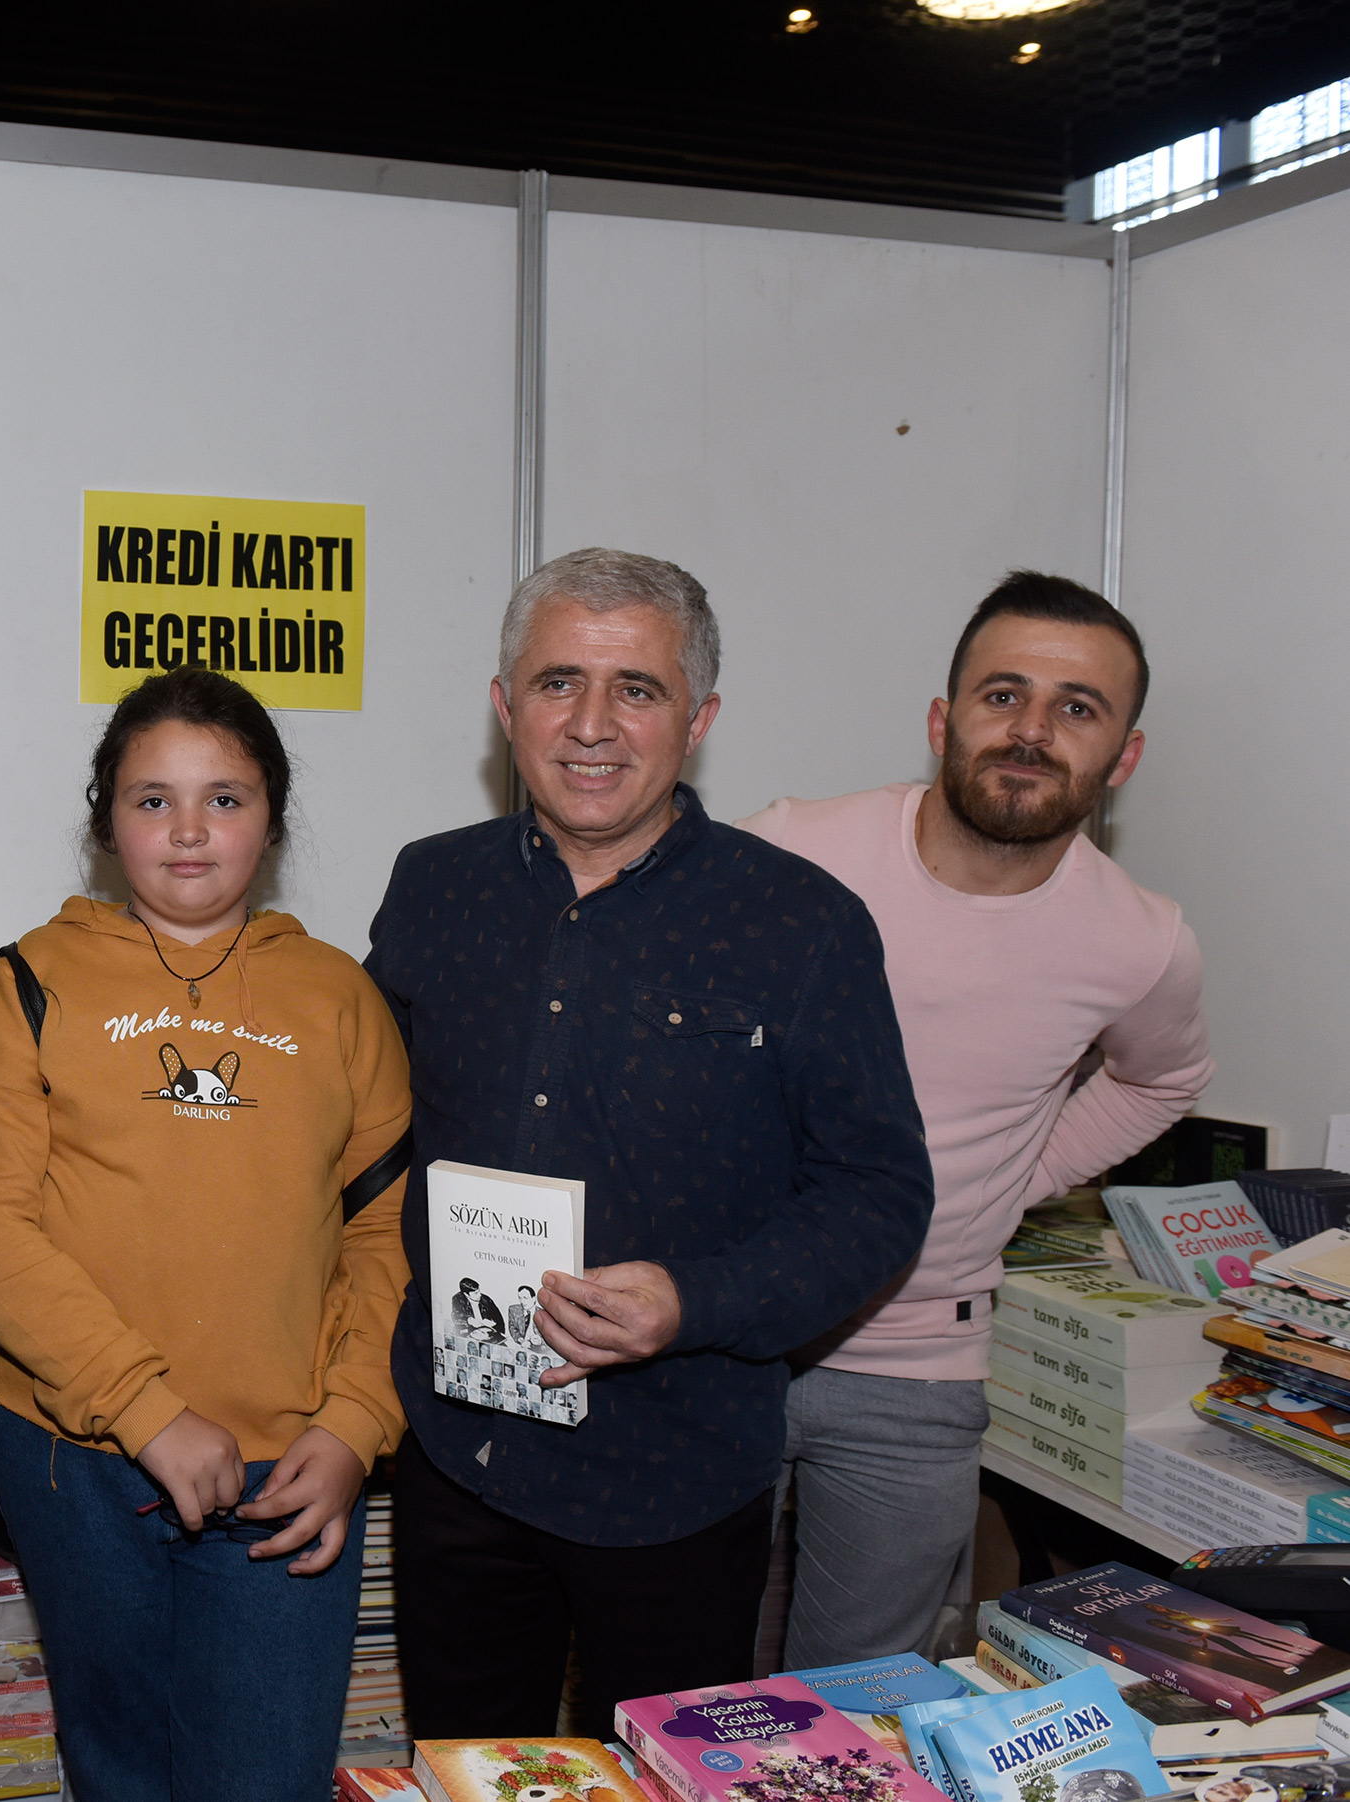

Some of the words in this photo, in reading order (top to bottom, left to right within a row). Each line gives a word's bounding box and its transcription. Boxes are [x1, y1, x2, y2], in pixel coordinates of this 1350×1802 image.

[97, 520, 220, 587] KREDİ
[232, 532, 353, 592] KARTI
[104, 607, 344, 674] GEÇERLİDİR
[104, 1006, 183, 1043] Make
[190, 1018, 225, 1034] me
[232, 1024, 299, 1055] smile
[173, 1104, 231, 1121] DARLING
[450, 1203, 503, 1230] SÖZÜN
[507, 1216, 549, 1238] ARDI
[1162, 1204, 1256, 1238] ÇOCUK
[1176, 1230, 1270, 1257] EĞİTİMİNDE
[474, 1251, 496, 1262] ÇETİN
[497, 1255, 526, 1267] ORANLI
[1034, 1308, 1060, 1329] tam
[1033, 1351, 1060, 1372] tam
[1030, 1392, 1056, 1415] tam
[1032, 1436, 1058, 1458] tam
[1035, 1582, 1067, 1594] Doğruluk
[1079, 1582, 1123, 1598] SUÇ
[1074, 1583, 1173, 1616] ORTAKLARI
[1049, 1618, 1075, 1635] Doğruluk
[1075, 1630, 1088, 1641] mu?
[1018, 1641, 1048, 1675] JOYCE
[805, 1665, 927, 1690] KAHRAMANLAR
[1151, 1673, 1190, 1695] ORTAKLARI
[1164, 1669, 1179, 1682] SUÇ
[863, 1684, 889, 1694] NE
[871, 1692, 908, 1706] YER?
[693, 1700, 768, 1718] Yasemin
[712, 1712, 776, 1728] Kokulu
[1012, 1710, 1037, 1728] TARİHİ
[1037, 1701, 1064, 1718] ROMAN
[988, 1722, 1065, 1773] HAYME
[1063, 1705, 1112, 1743] ANA
[1322, 1719, 1350, 1739] hayykitap
[1089, 1736, 1110, 1753] ANASI
[709, 1754, 728, 1764] Kokulu
[719, 1759, 733, 1767] Kitap
[654, 1752, 686, 1791] Yasemin
